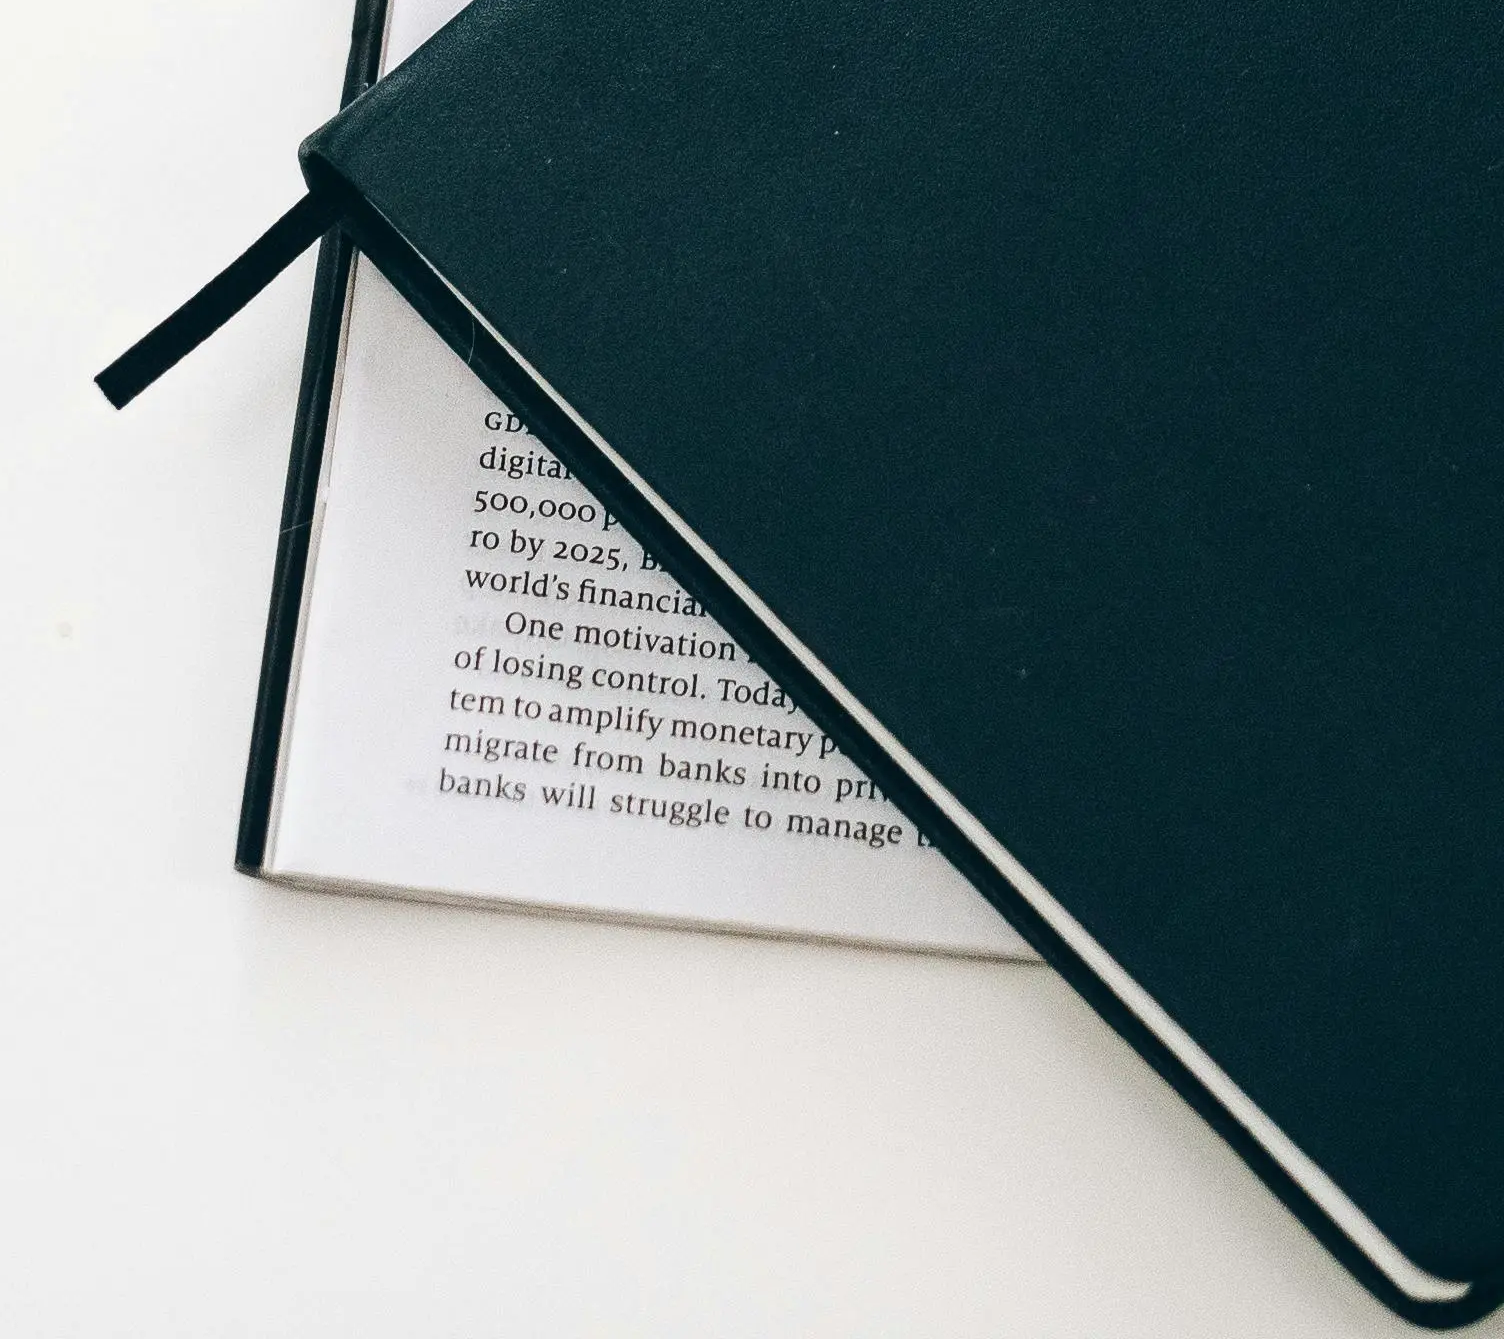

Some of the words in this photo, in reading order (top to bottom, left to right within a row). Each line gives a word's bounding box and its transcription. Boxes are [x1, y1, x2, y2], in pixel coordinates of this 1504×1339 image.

[473, 489, 597, 523] 500,000
[468, 528, 500, 551] ro
[509, 527, 545, 562] by
[552, 539, 628, 572] 2025,
[464, 568, 570, 601] world's
[503, 610, 564, 641] One
[572, 624, 736, 662] motivation
[453, 645, 485, 671] of
[492, 647, 583, 690] losing
[590, 667, 706, 700] control.
[449, 688, 505, 716] tem
[513, 695, 542, 720] to
[547, 702, 664, 741] amplify
[669, 718, 814, 758] monetary
[443, 728, 559, 764] migrate
[571, 740, 643, 775] from
[658, 751, 747, 786] banks
[760, 761, 822, 795] into
[438, 766, 526, 802] banks
[540, 781, 596, 811] will
[609, 793, 730, 828] struggle
[743, 805, 773, 830] to
[785, 813, 903, 849] manage
